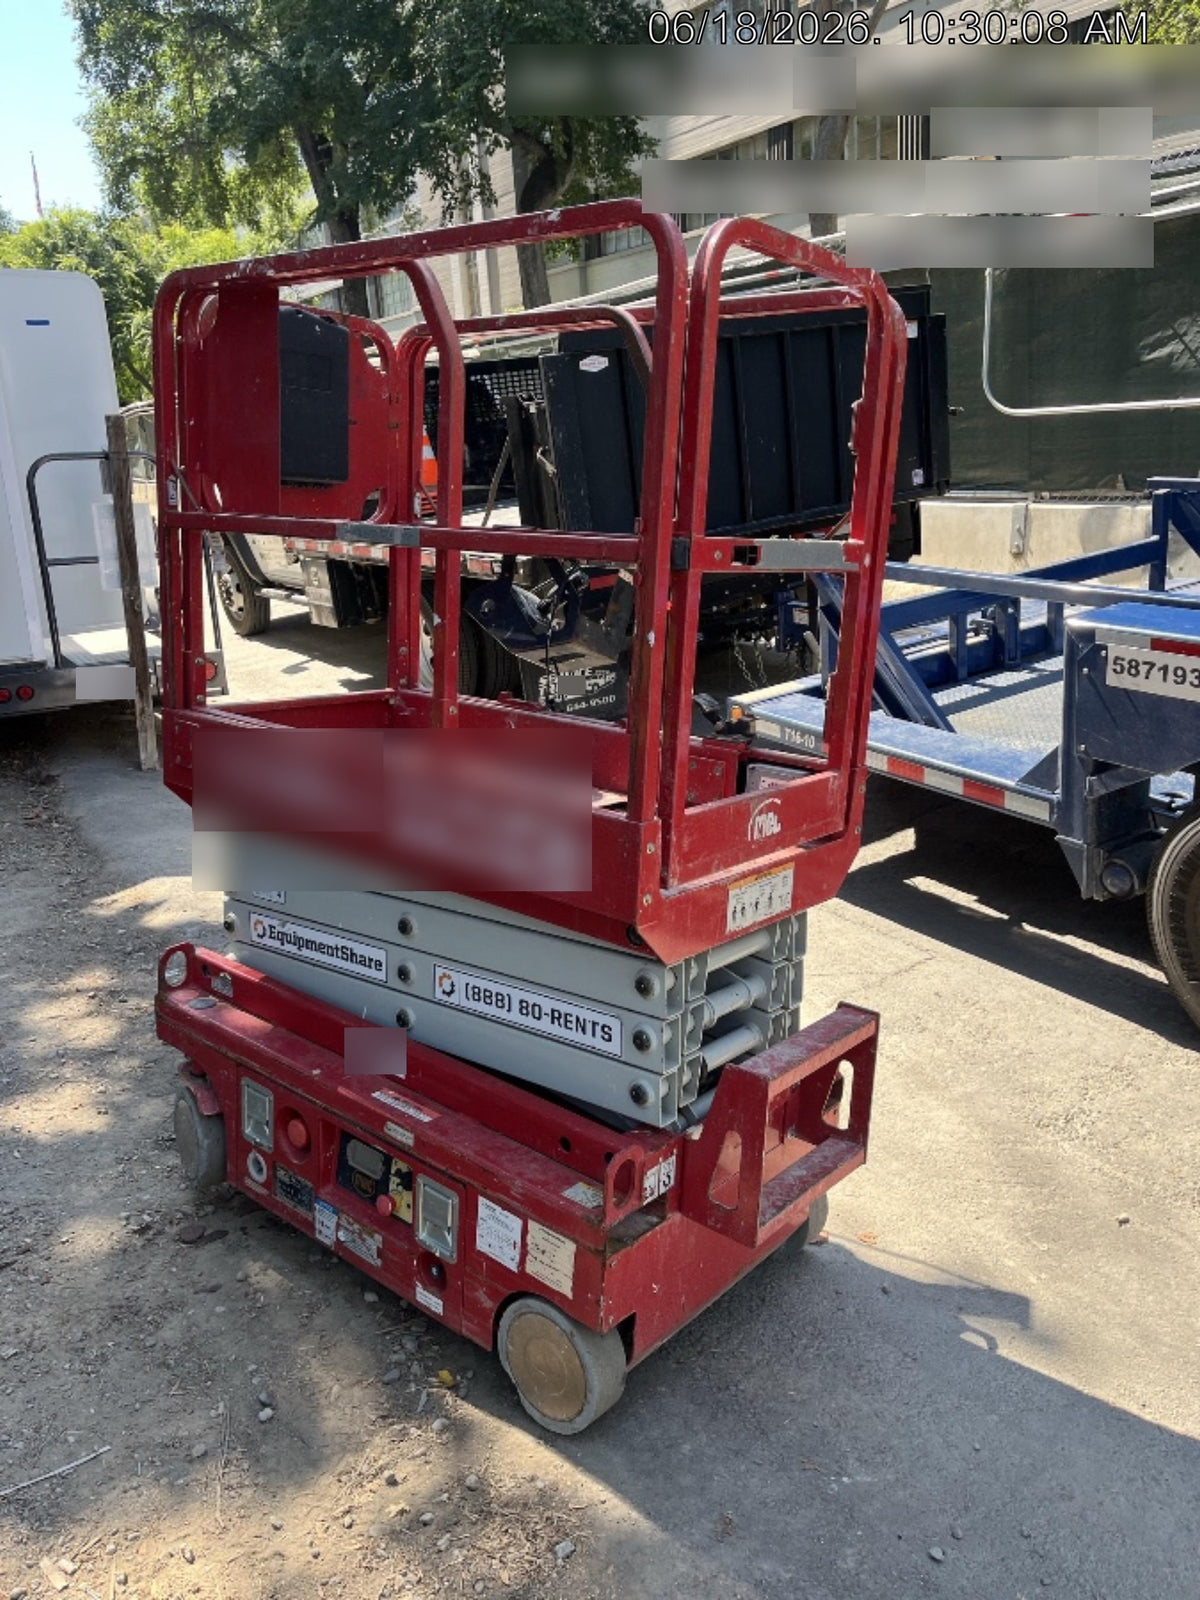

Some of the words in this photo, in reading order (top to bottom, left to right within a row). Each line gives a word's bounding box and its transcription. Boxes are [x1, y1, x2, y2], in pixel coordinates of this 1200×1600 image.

[1111, 655, 1200, 689] 587193
[268, 924, 384, 972] EquipmentShare
[518, 998, 613, 1043] 80-RENTS
